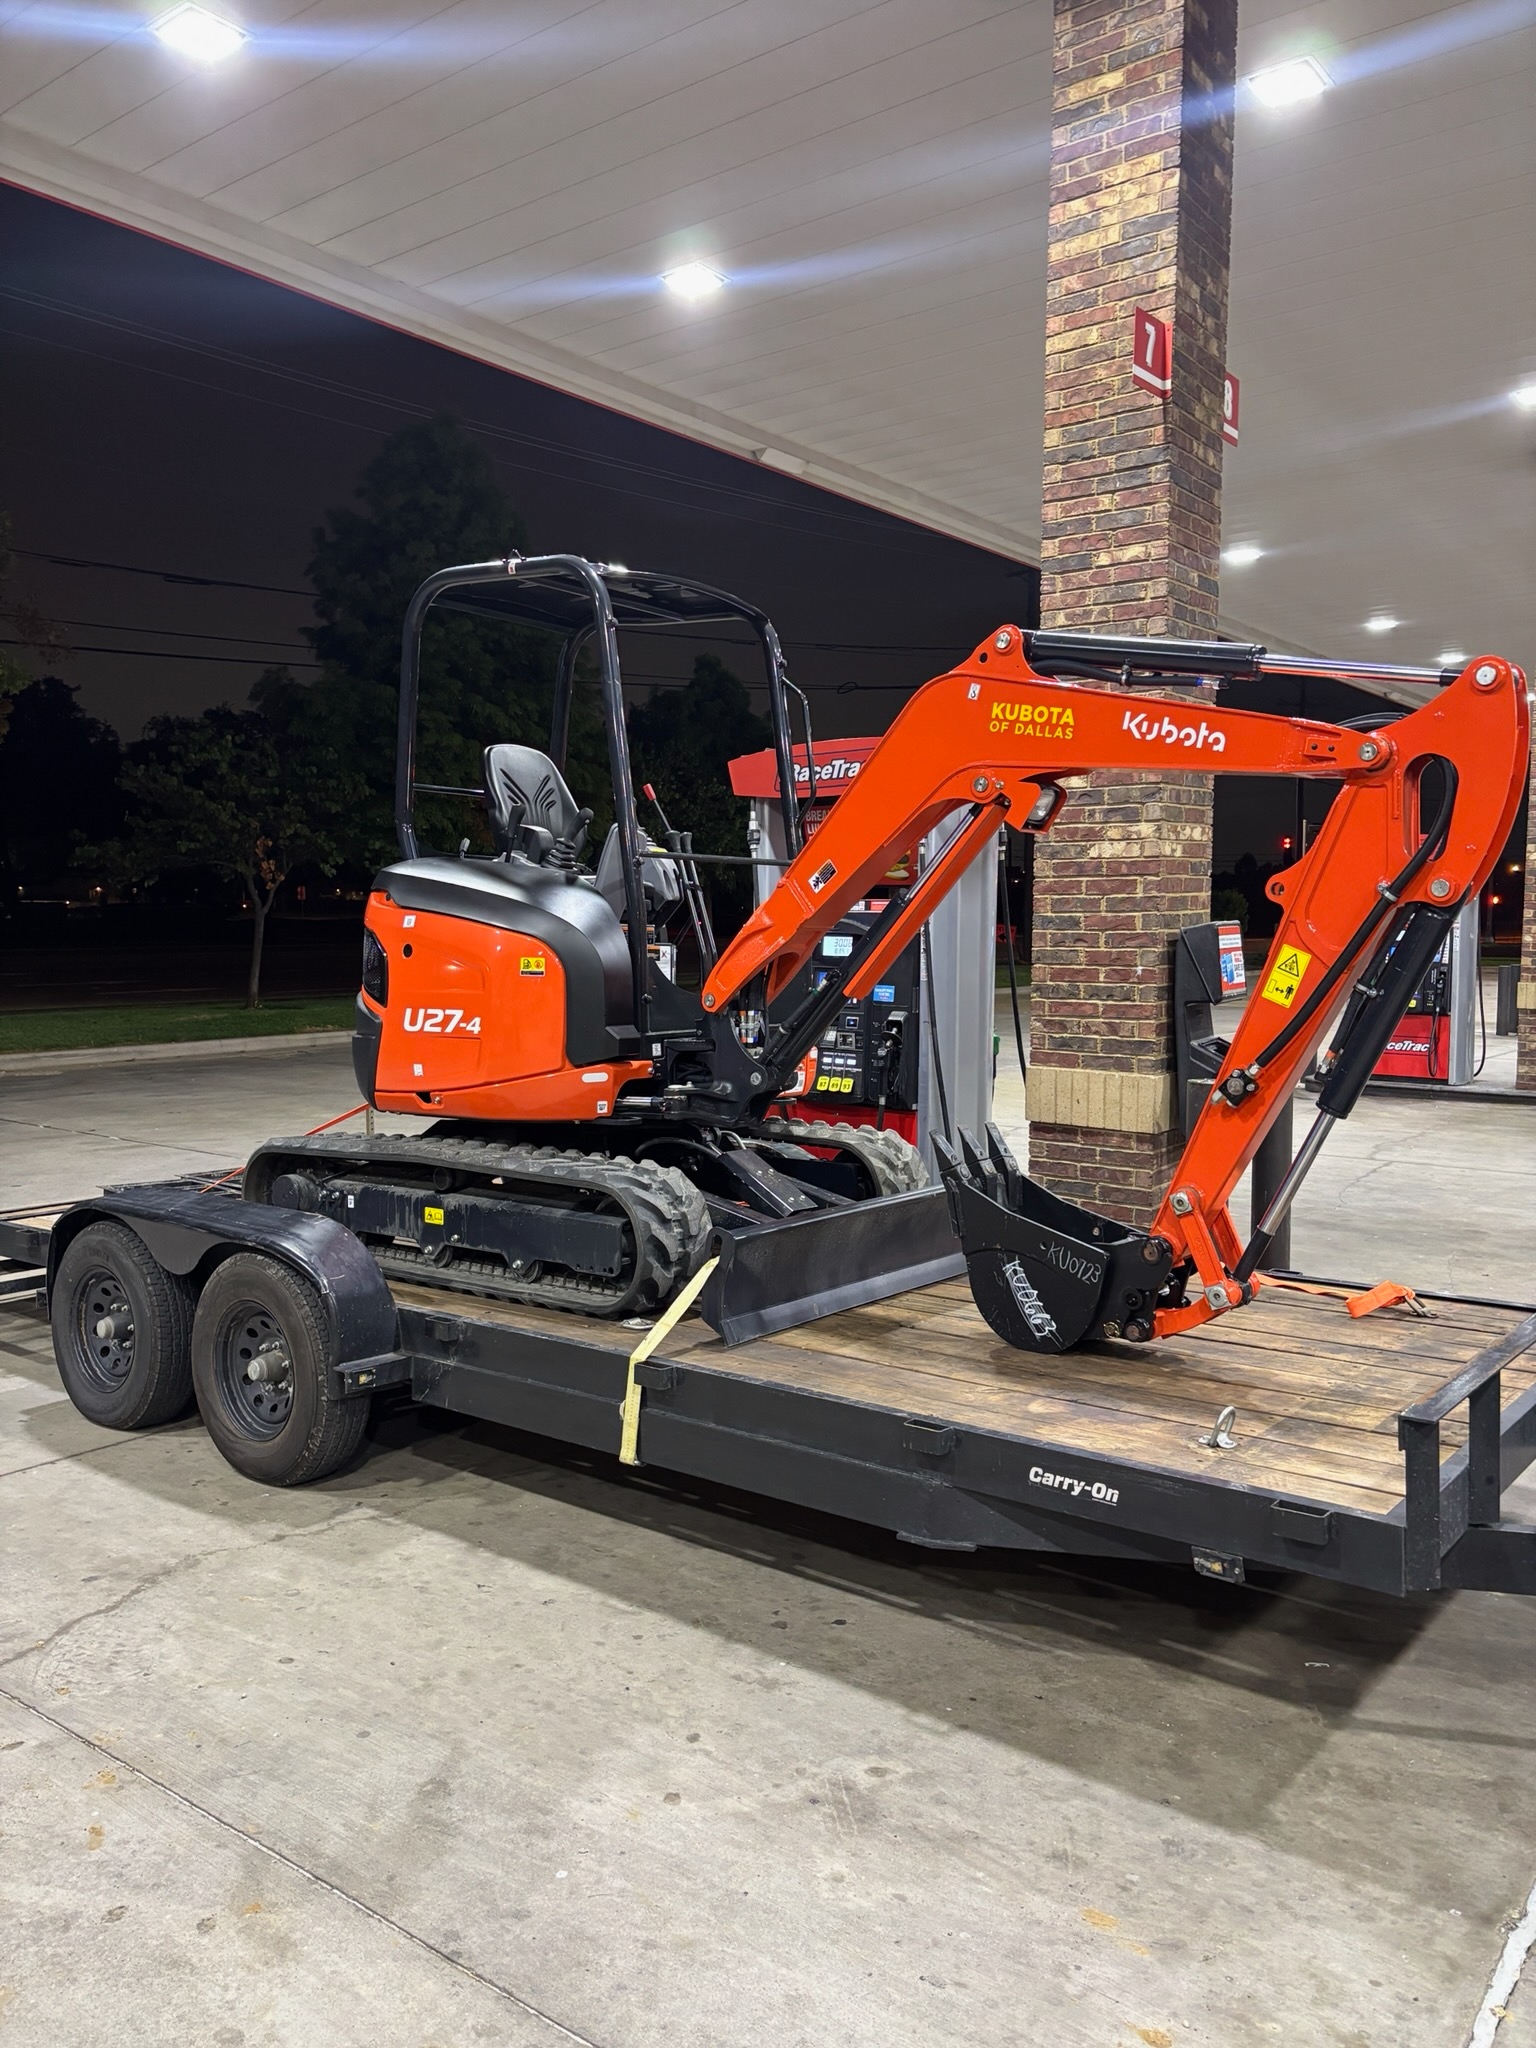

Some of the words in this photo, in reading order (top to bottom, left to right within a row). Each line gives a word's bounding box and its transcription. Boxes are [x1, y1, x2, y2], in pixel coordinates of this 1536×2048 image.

[1145, 321, 1156, 367] 7
[990, 701, 1075, 726] KUBOTA
[989, 721, 1009, 733] OF
[1014, 723, 1074, 740] DALLAS
[1122, 710, 1227, 752] Kubota
[793, 759, 862, 783] RaceTra
[403, 1007, 482, 1035] U27-4
[1045, 1241, 1102, 1285] KU0723
[1028, 1466, 1120, 1503] Carry-On
